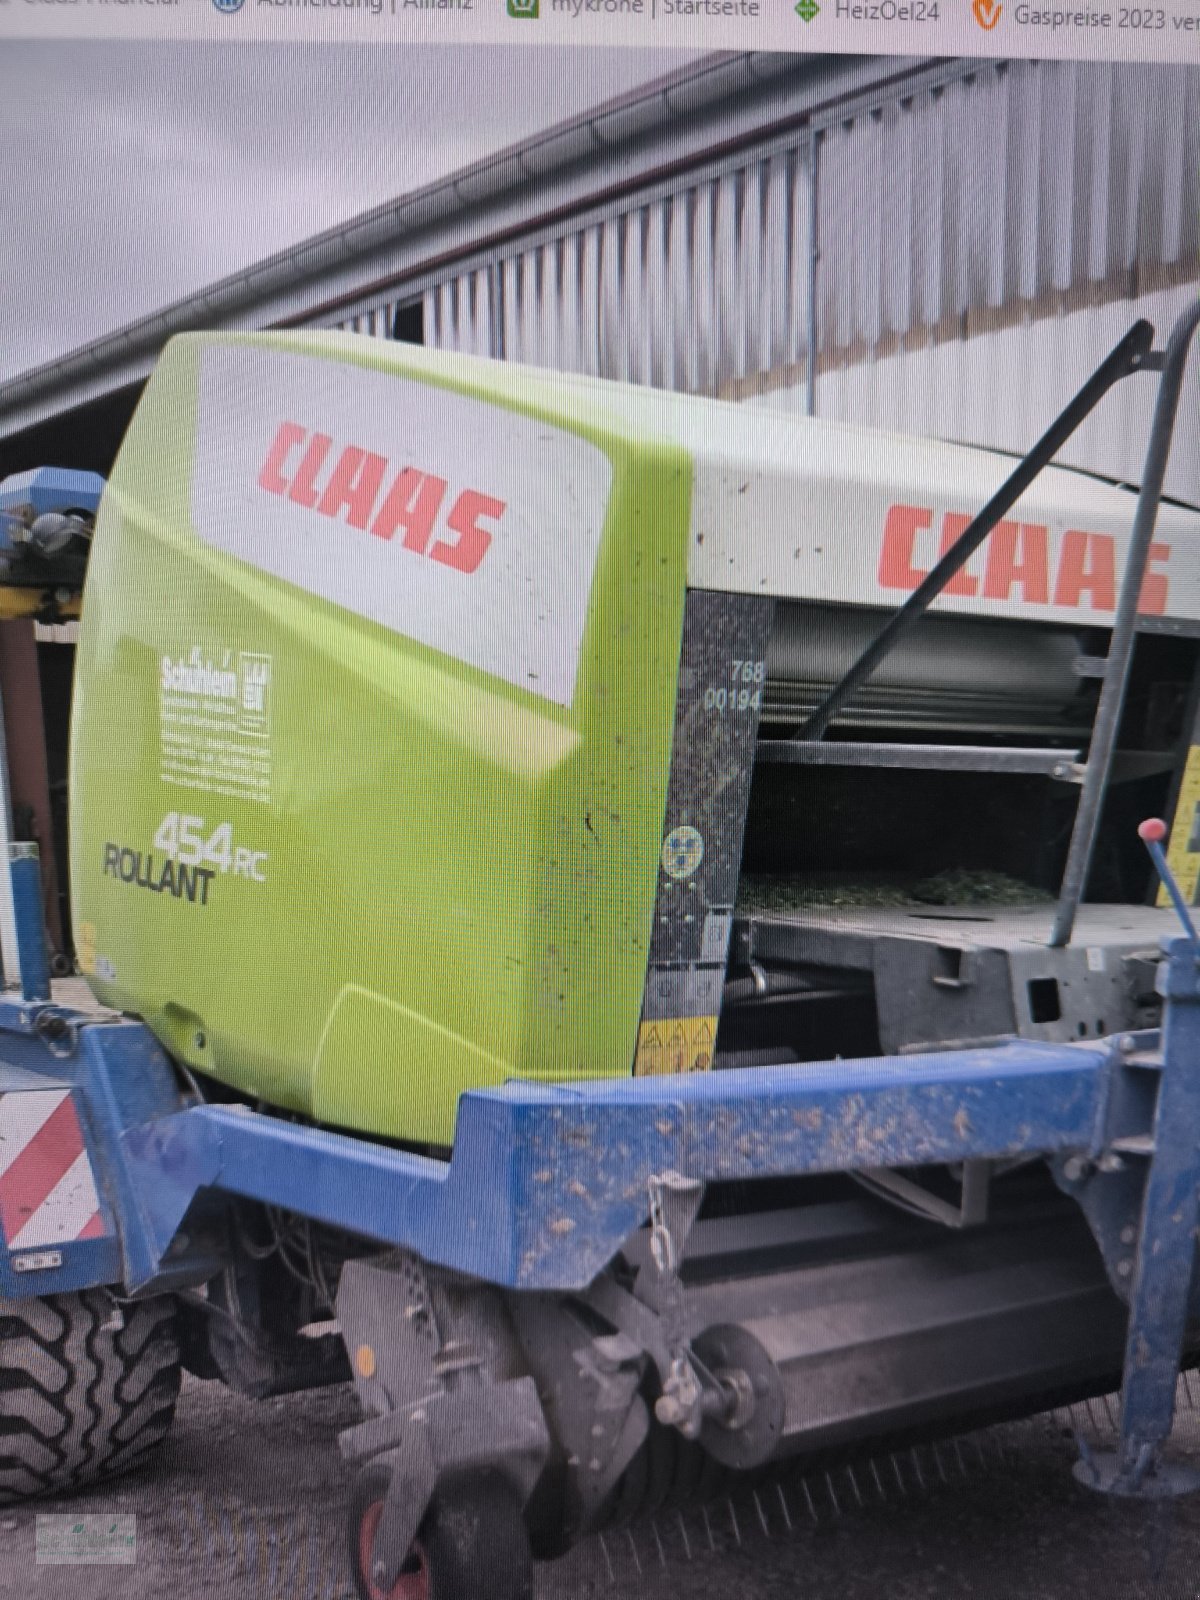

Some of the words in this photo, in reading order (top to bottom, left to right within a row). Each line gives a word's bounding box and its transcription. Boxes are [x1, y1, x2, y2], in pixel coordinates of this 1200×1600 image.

[551, 0, 644, 18] mykrone
[664, 0, 760, 17] Startseite
[835, 0, 940, 22] HeizOel24
[1014, 5, 1112, 32] Gaspreise
[1118, 8, 1166, 30] 2023
[257, 420, 507, 575] CLAAS
[731, 659, 765, 683] 768
[703, 687, 763, 712] 00194
[155, 812, 233, 873] 454
[234, 847, 269, 882] RC
[103, 841, 216, 905] ROLLANT
